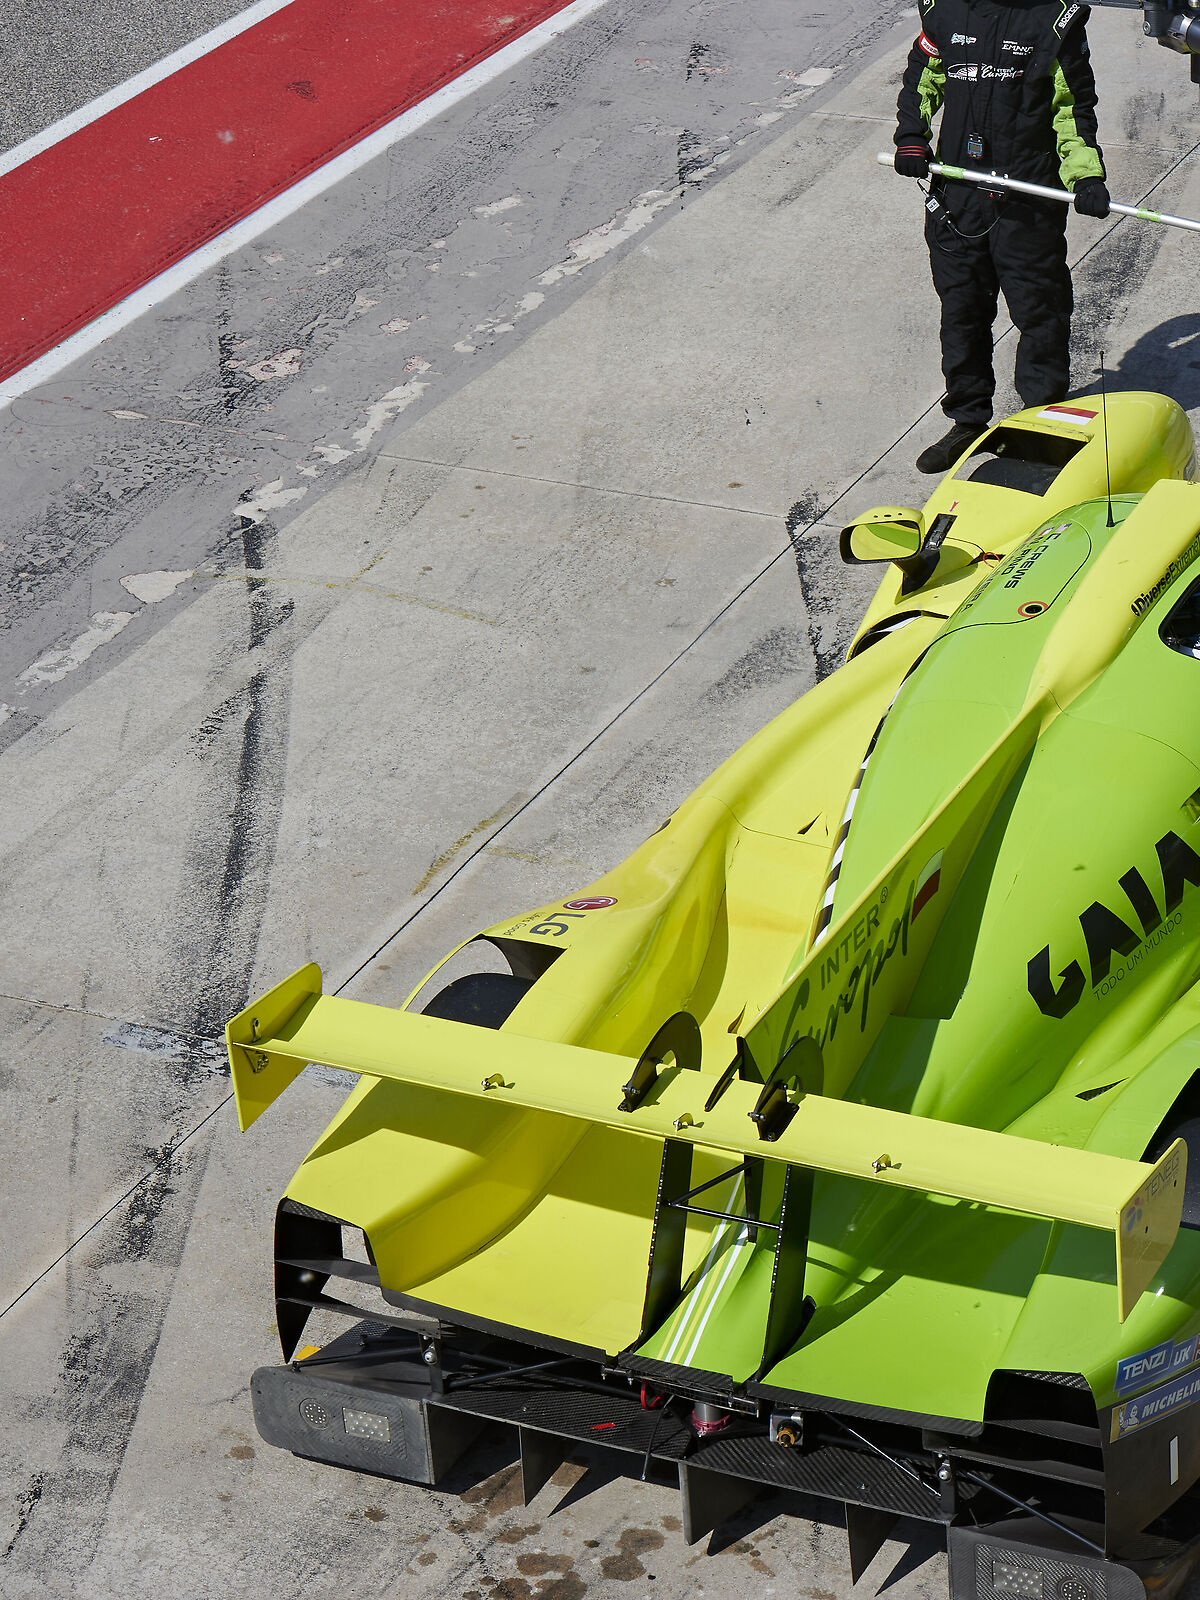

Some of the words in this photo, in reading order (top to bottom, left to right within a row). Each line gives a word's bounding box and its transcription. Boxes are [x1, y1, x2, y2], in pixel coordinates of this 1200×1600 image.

[1003, 545, 1048, 589] CREWS
[529, 912, 586, 937] LG
[1093, 967, 1125, 1000] TODO
[1126, 952, 1144, 970] UM
[1144, 912, 1183, 950] MUNDO
[1122, 1349, 1167, 1381] TENZI
[1173, 1344, 1192, 1366] UK
